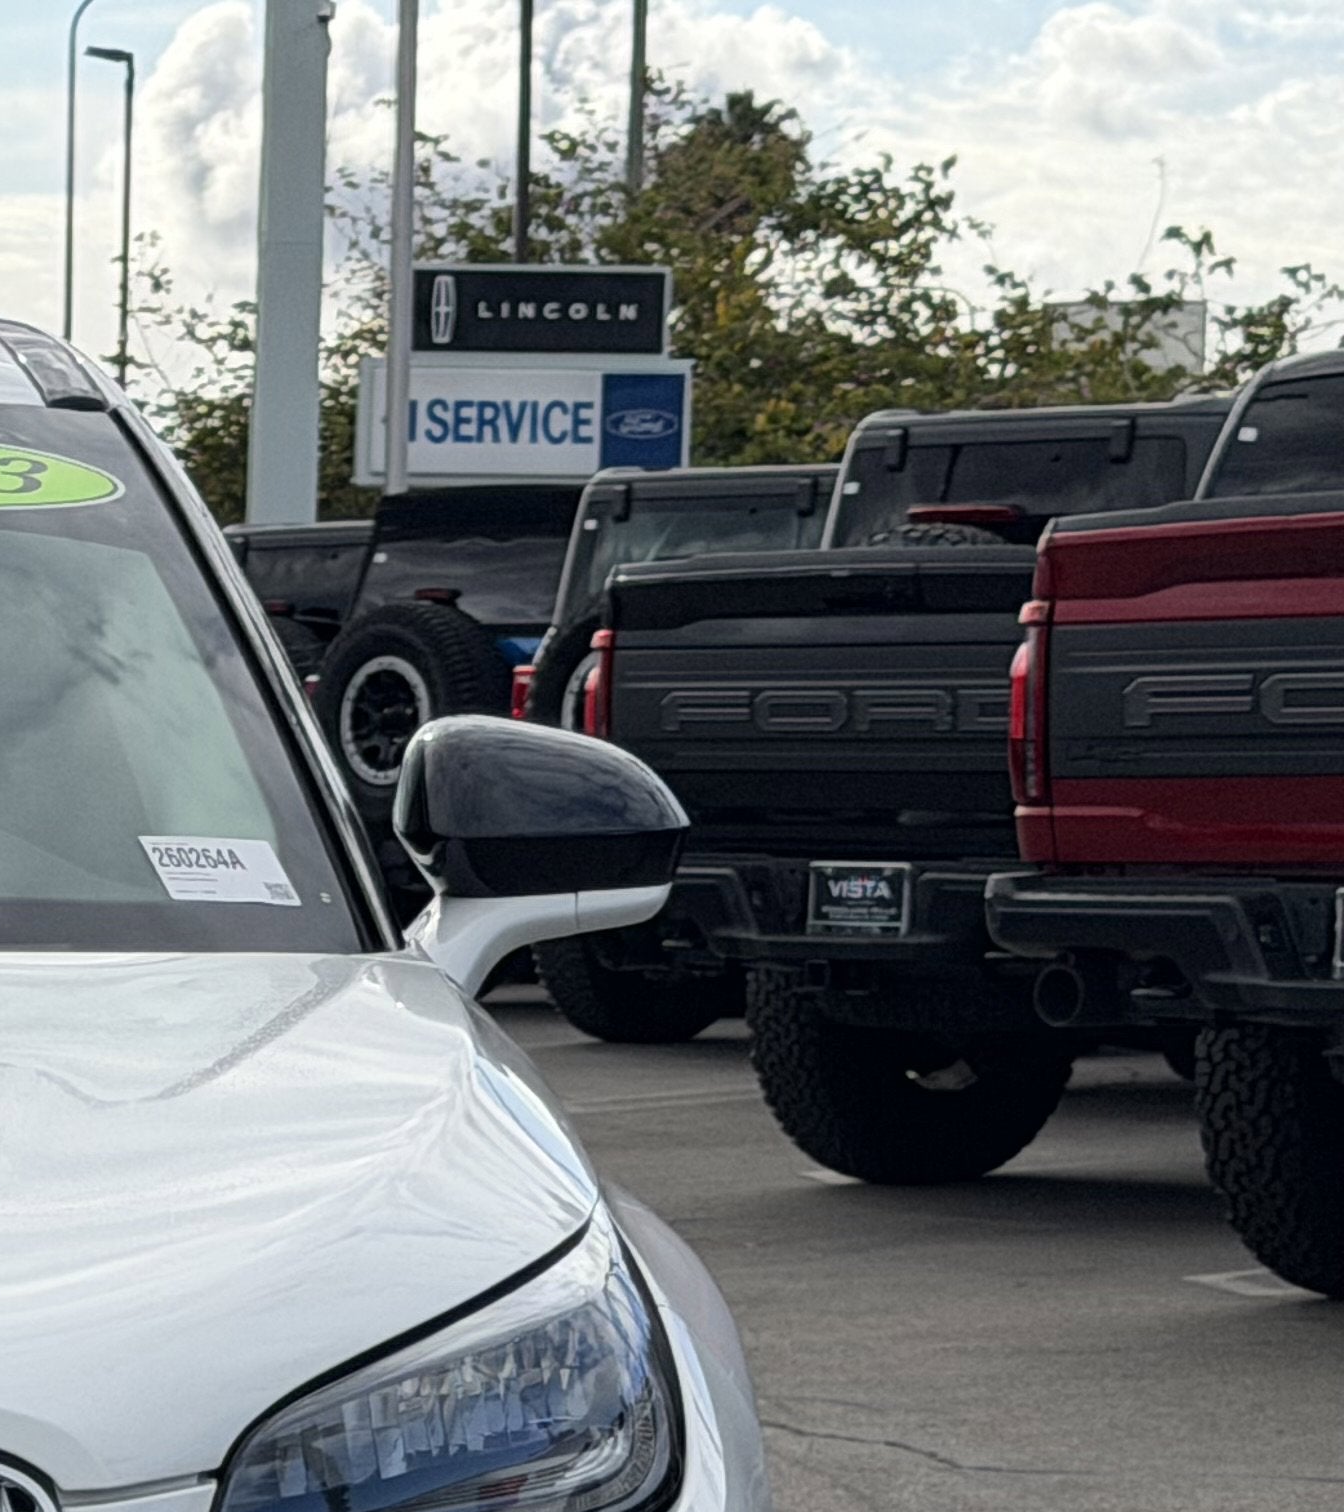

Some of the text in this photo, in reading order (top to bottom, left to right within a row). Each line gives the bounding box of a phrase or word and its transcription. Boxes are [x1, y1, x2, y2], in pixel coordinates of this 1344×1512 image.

[477, 300, 639, 321] LINCOLN
[424, 398, 594, 445] SERVICE
[827, 879, 893, 899] VISTA
